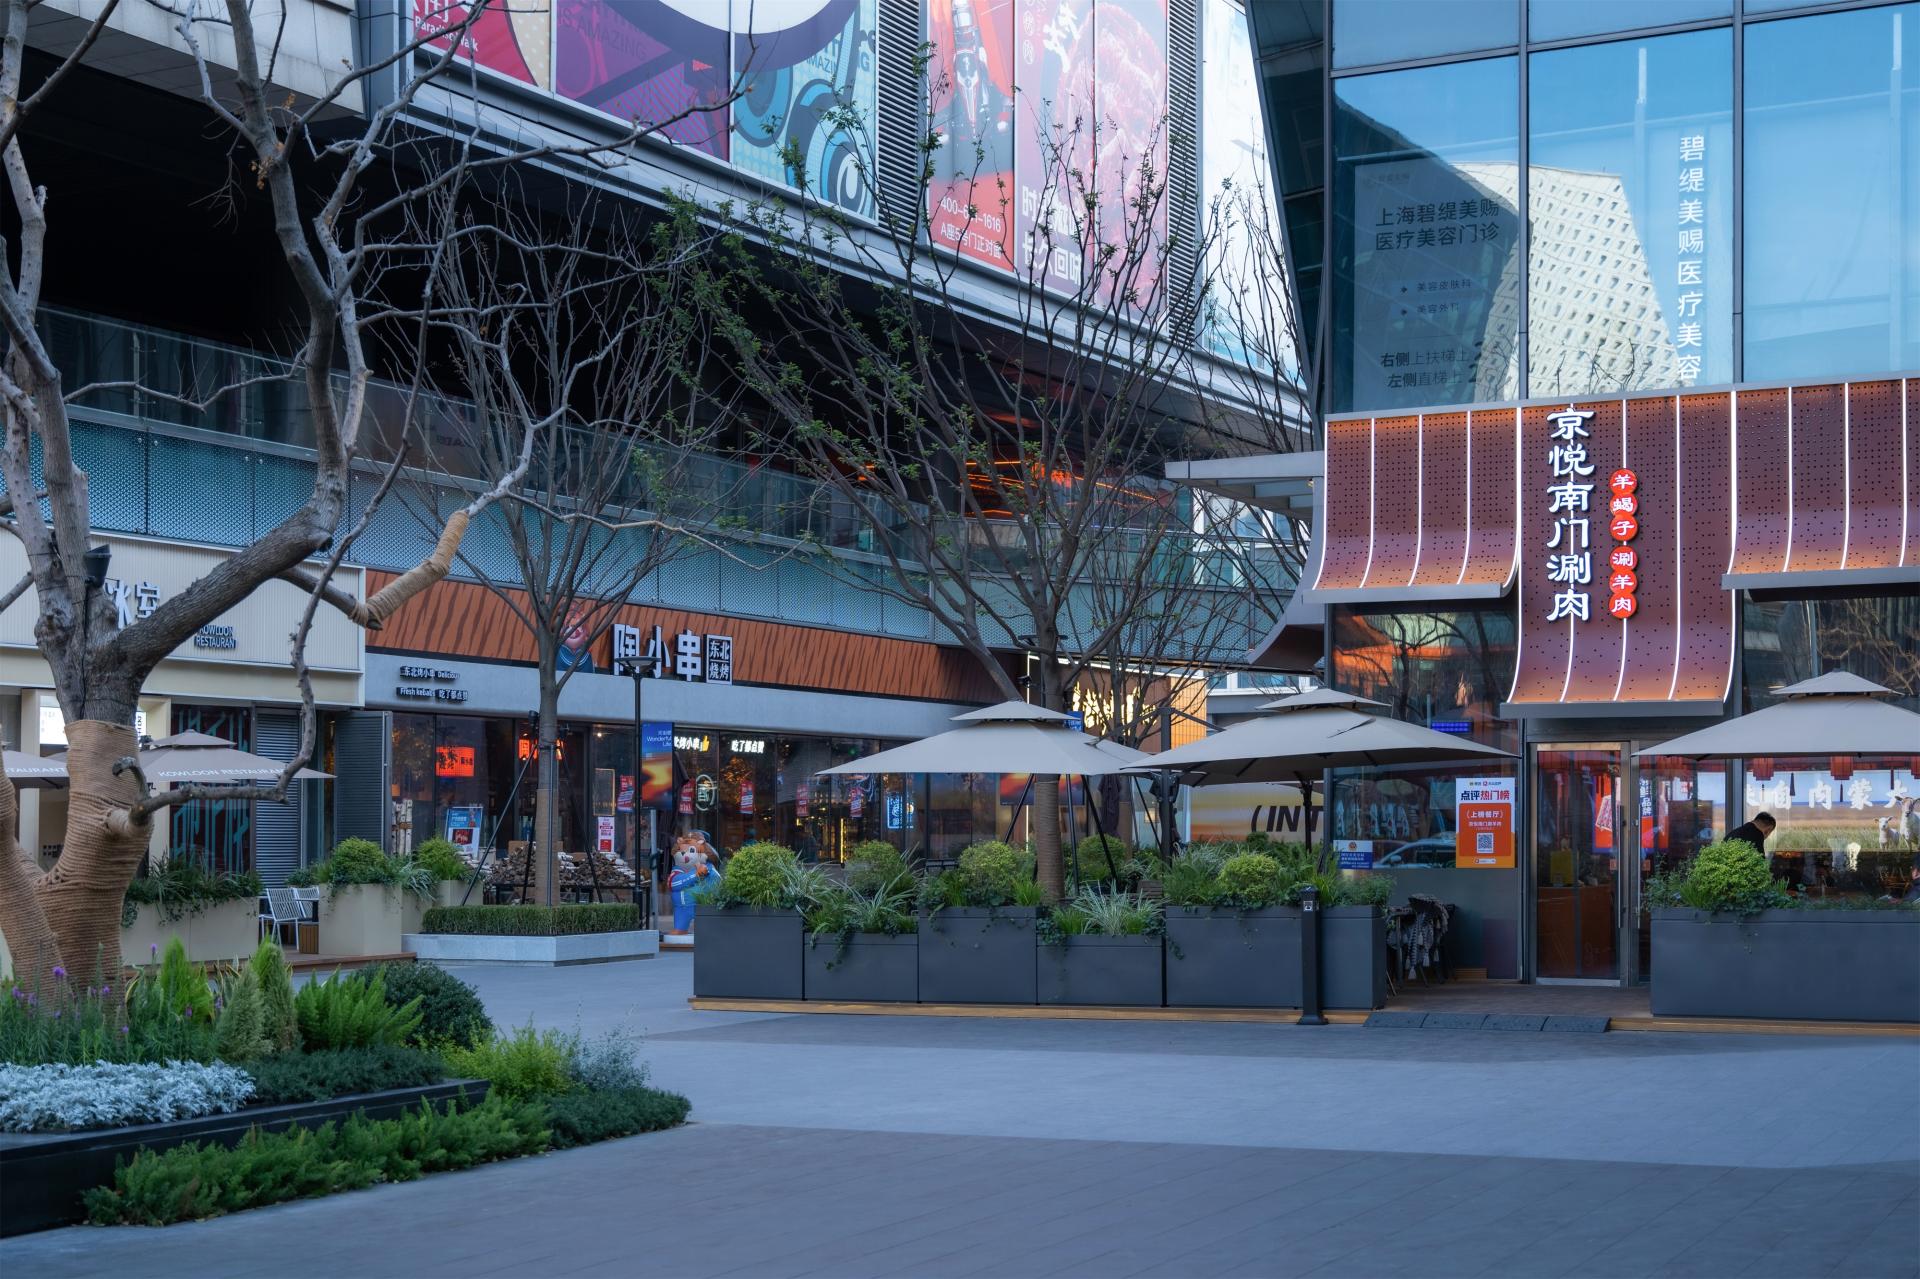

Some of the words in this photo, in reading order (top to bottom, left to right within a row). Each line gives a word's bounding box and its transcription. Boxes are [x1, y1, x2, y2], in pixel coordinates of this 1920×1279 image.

[940, 195, 1001, 233] 400-61-1616
[1375, 198, 1500, 227] 上海碧缇美赐
[1375, 221, 1500, 251] 医疗美容门诊
[1677, 134, 1706, 381] 碧缇美赐医疗美容
[1546, 408, 1596, 622] 京悦南门涮肉
[1460, 790, 1510, 801] 点评热门榜
